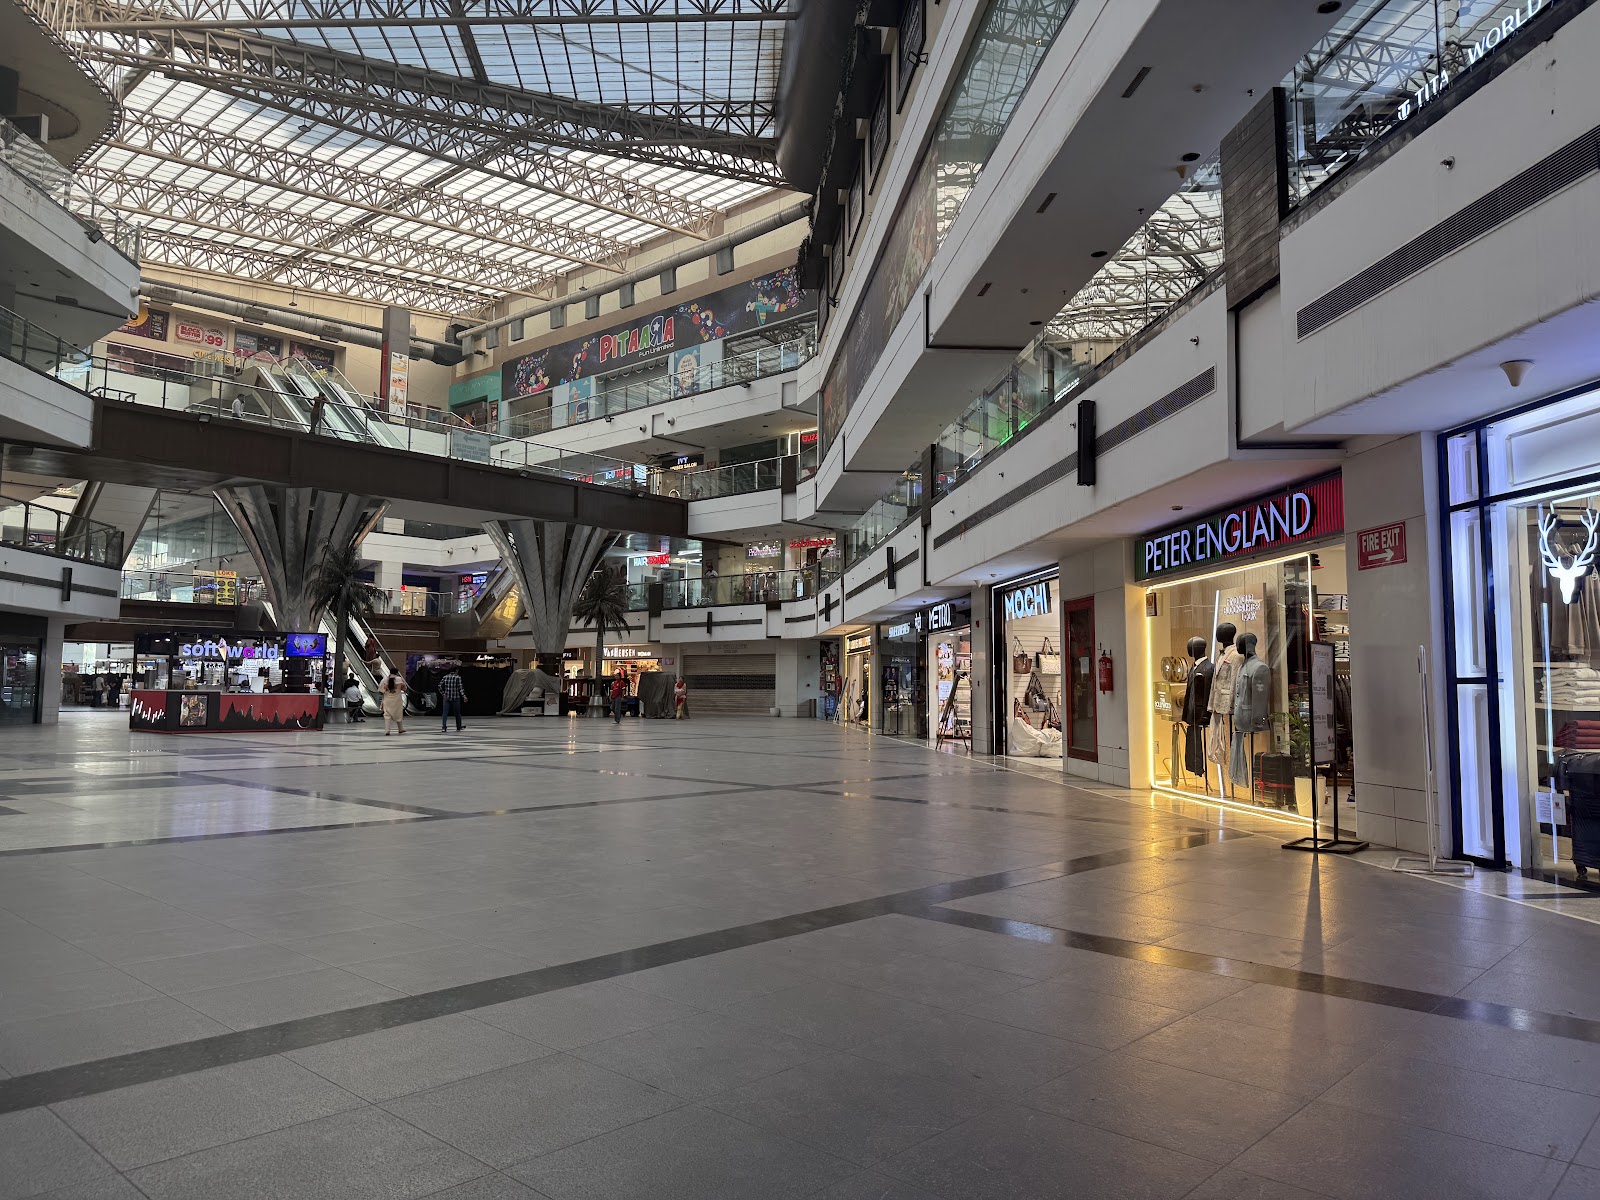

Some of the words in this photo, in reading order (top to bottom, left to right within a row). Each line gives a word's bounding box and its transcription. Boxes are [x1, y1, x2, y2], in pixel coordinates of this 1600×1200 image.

[1467, 0, 1542, 64] WORLD
[600, 315, 675, 363] PITAARA
[1145, 529, 1191, 574] PETER
[1196, 492, 1311, 561] ENGLAND
[1362, 533, 1380, 553] FIRE
[1381, 528, 1400, 549] EXIT
[1004, 582, 1048, 621] MOCHI
[182, 640, 218, 657] soft
[228, 643, 278, 659] world
